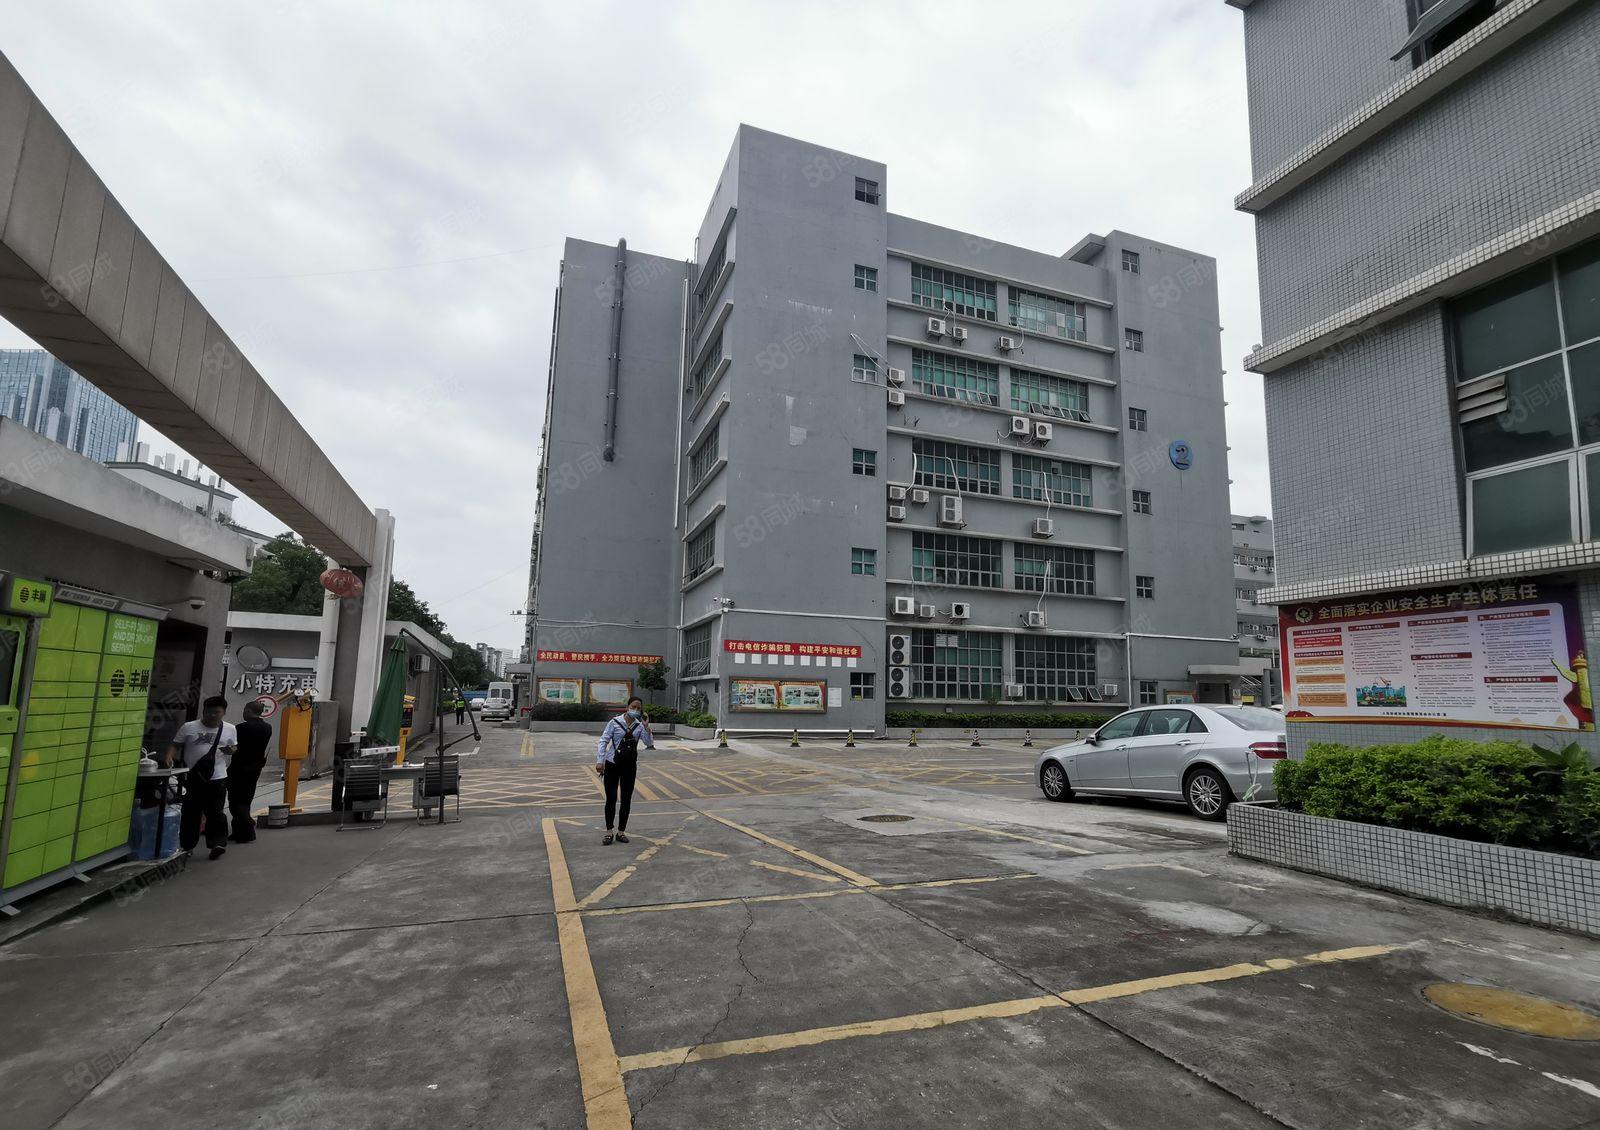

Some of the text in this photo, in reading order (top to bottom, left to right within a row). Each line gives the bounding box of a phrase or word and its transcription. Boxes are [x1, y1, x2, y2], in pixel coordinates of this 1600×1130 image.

[1175, 445, 1189, 466] 2
[1318, 584, 1538, 620] 全面落实企业安全生产主体责任
[129, 669, 149, 692] 丰巢
